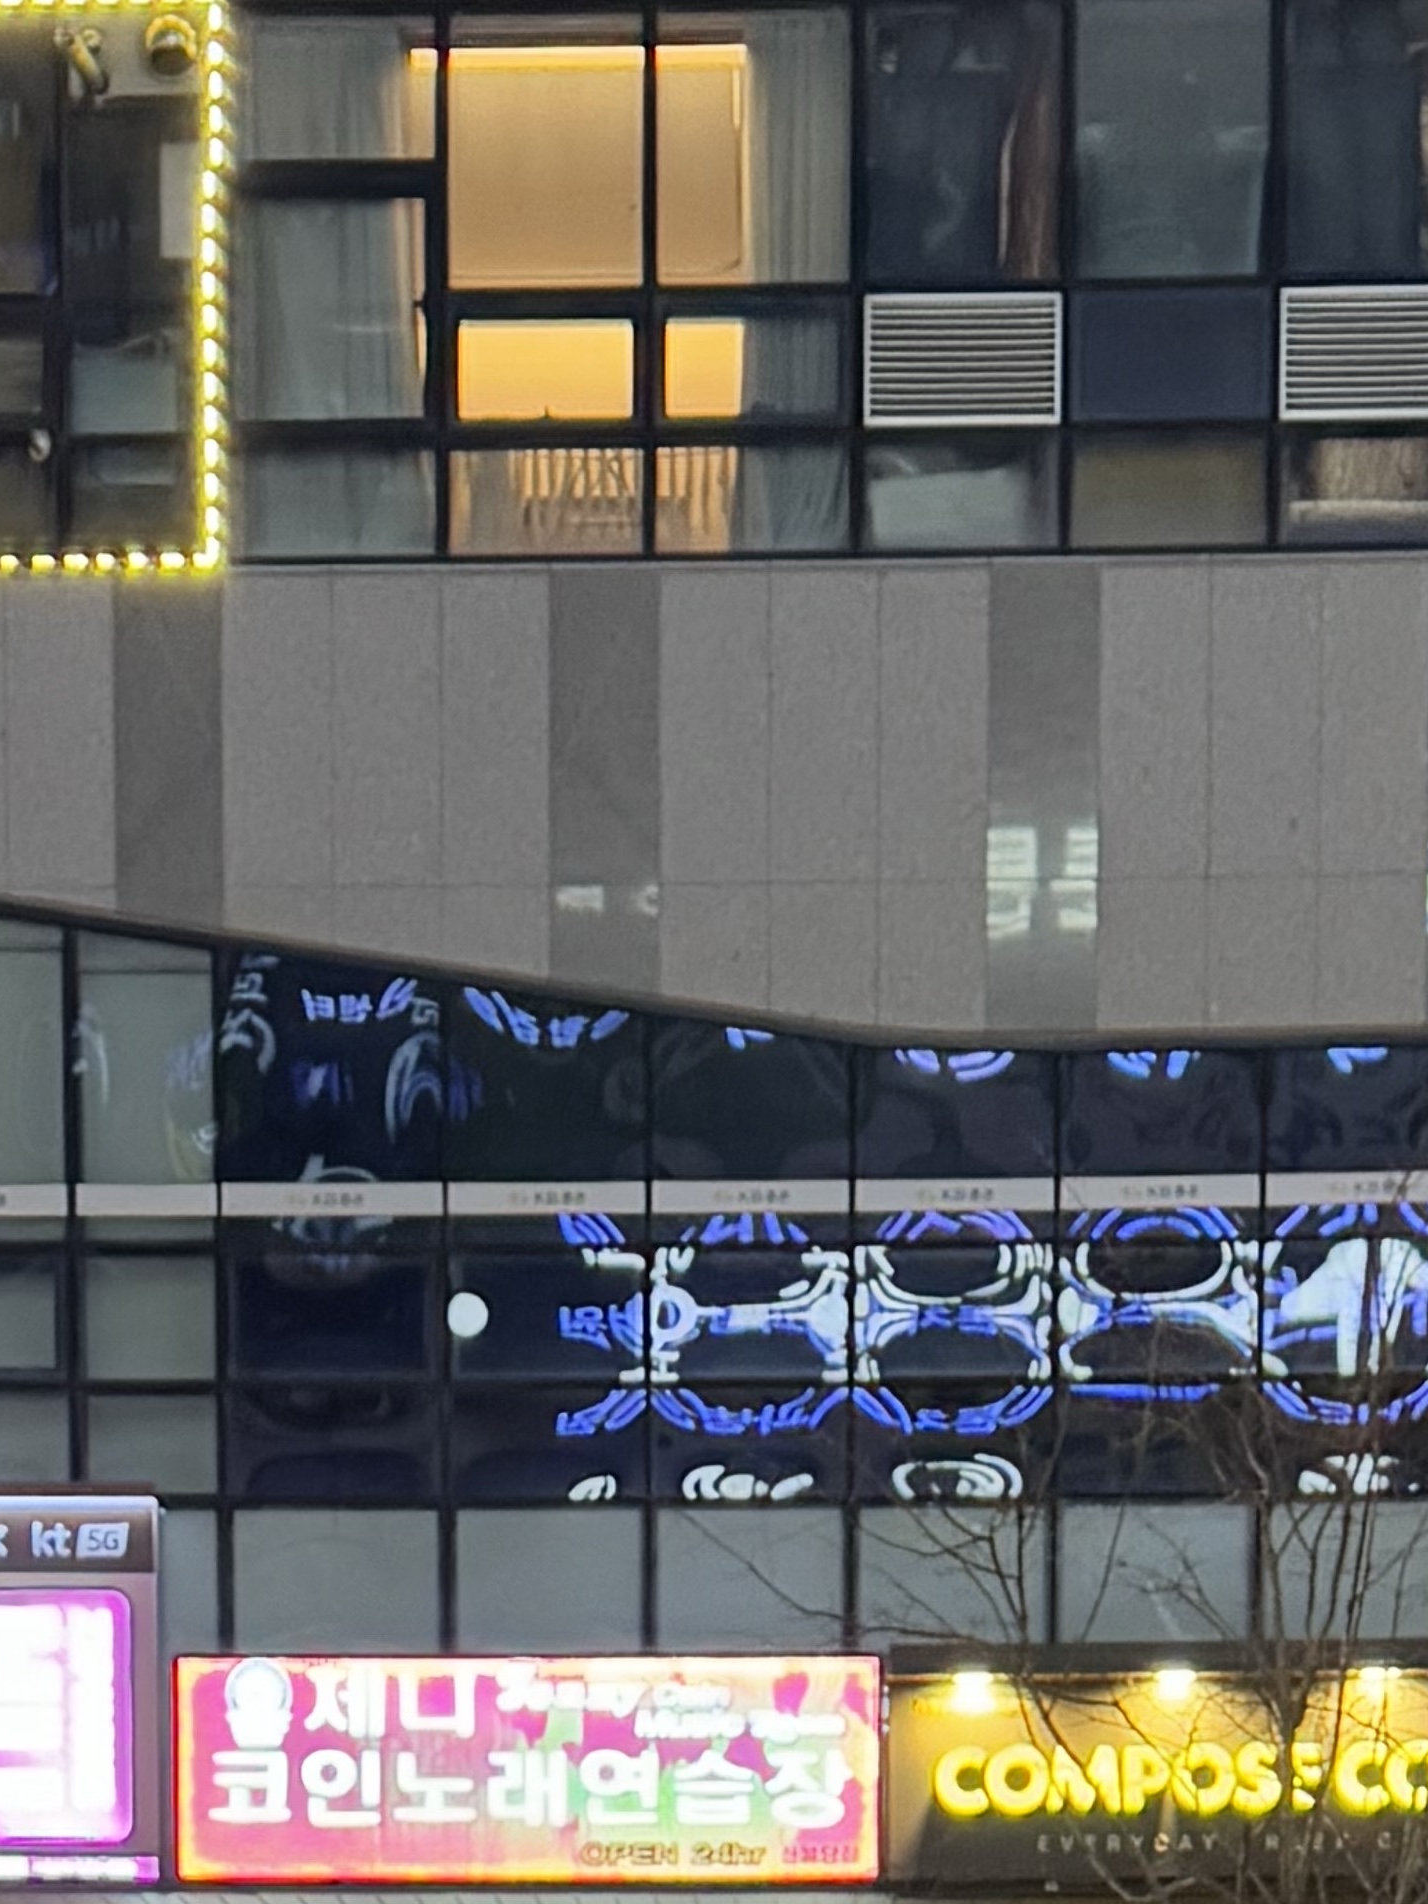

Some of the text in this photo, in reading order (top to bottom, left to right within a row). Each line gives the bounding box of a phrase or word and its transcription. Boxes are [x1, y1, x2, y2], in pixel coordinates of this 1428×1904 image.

[30, 1520, 71, 1558] kt
[304, 1661, 478, 1739] 제니
[209, 1746, 851, 1829] 코인노래연습장
[933, 1742, 1315, 1817] COMPOSE
[580, 1842, 768, 1866] OPEN 24hr
